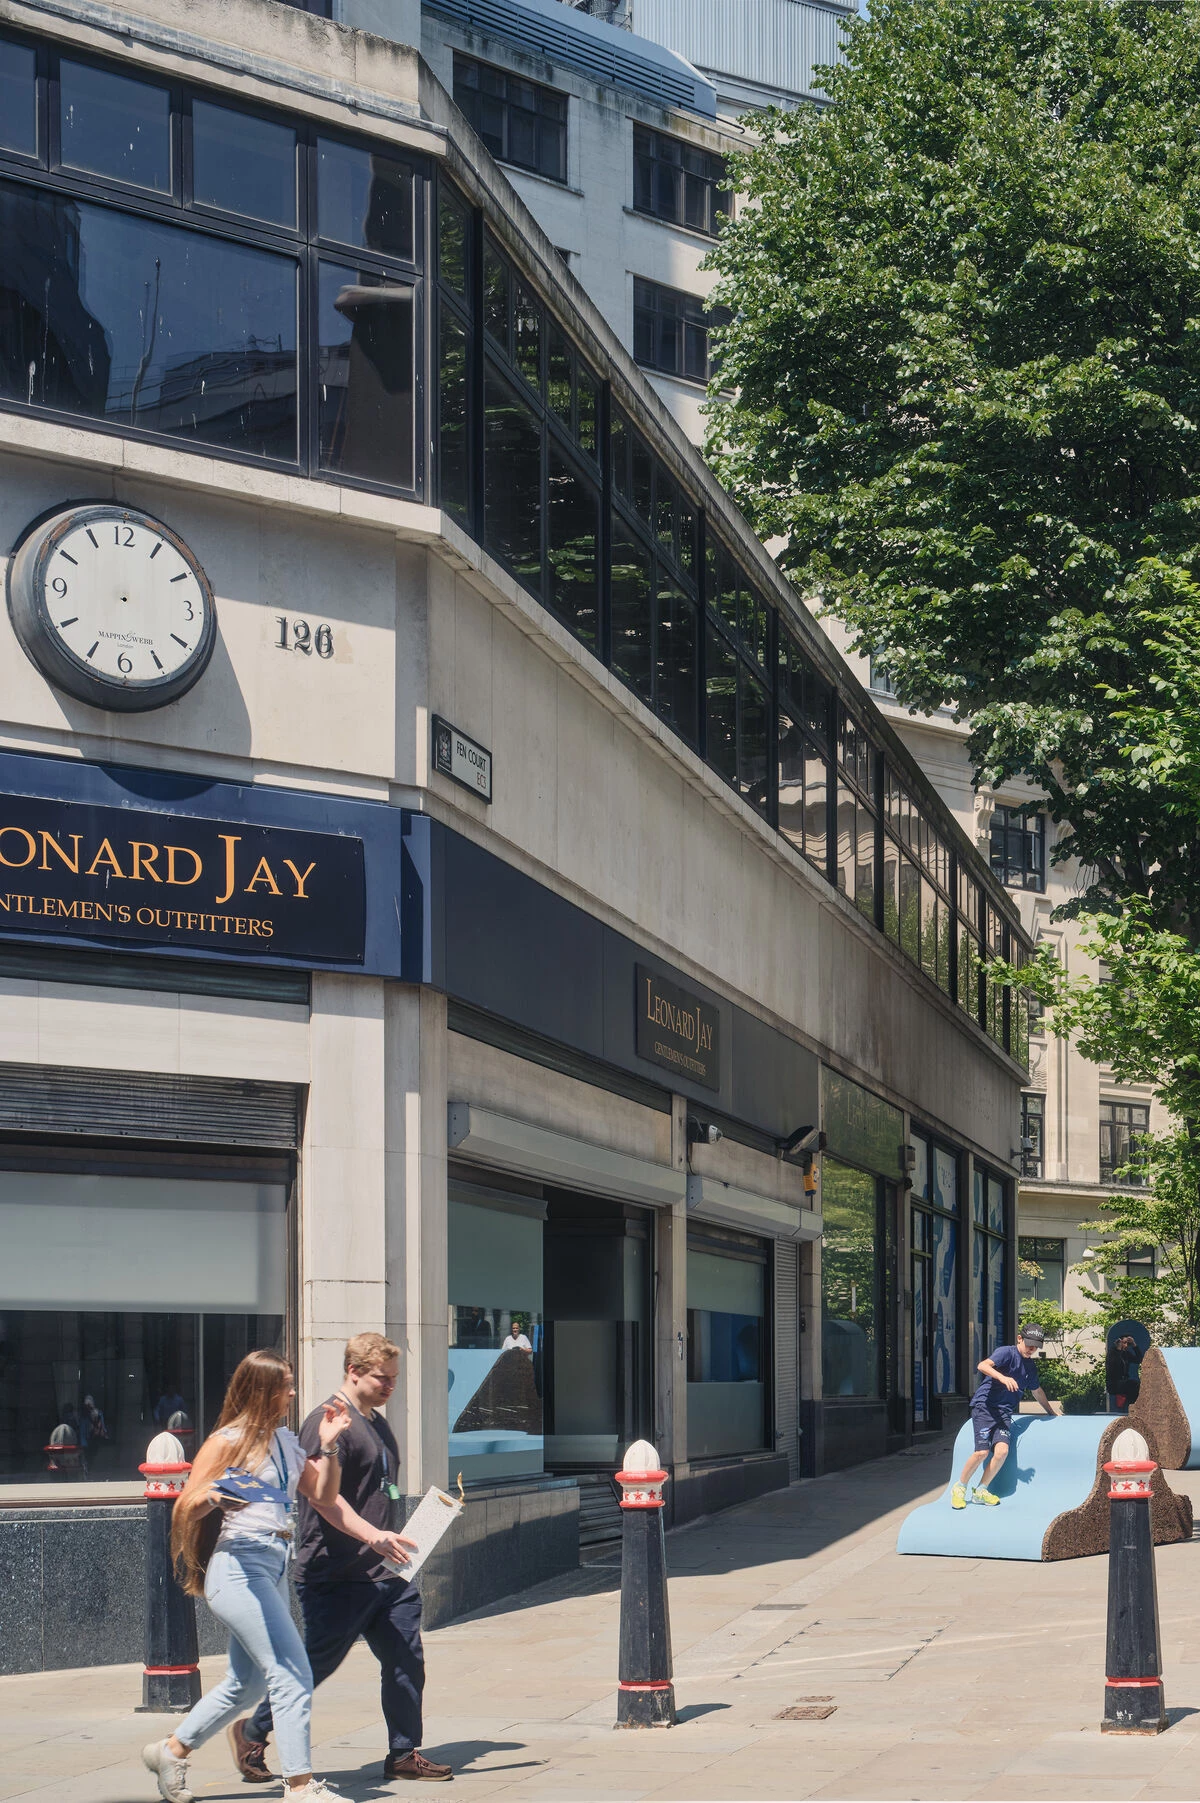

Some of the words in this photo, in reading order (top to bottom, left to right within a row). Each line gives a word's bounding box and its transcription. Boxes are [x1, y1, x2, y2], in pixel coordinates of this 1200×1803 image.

[114, 526, 136, 547] 12
[52, 577, 68, 599] 9
[183, 600, 194, 621] 3
[98, 630, 126, 641] MAPPIN
[132, 636, 153, 646] WEBB
[274, 615, 333, 659] 126
[117, 652, 133, 674] 6
[456, 740, 467, 759] FEN
[468, 749, 487, 772] COURT
[136, 907, 274, 938] OUTFITTERS
